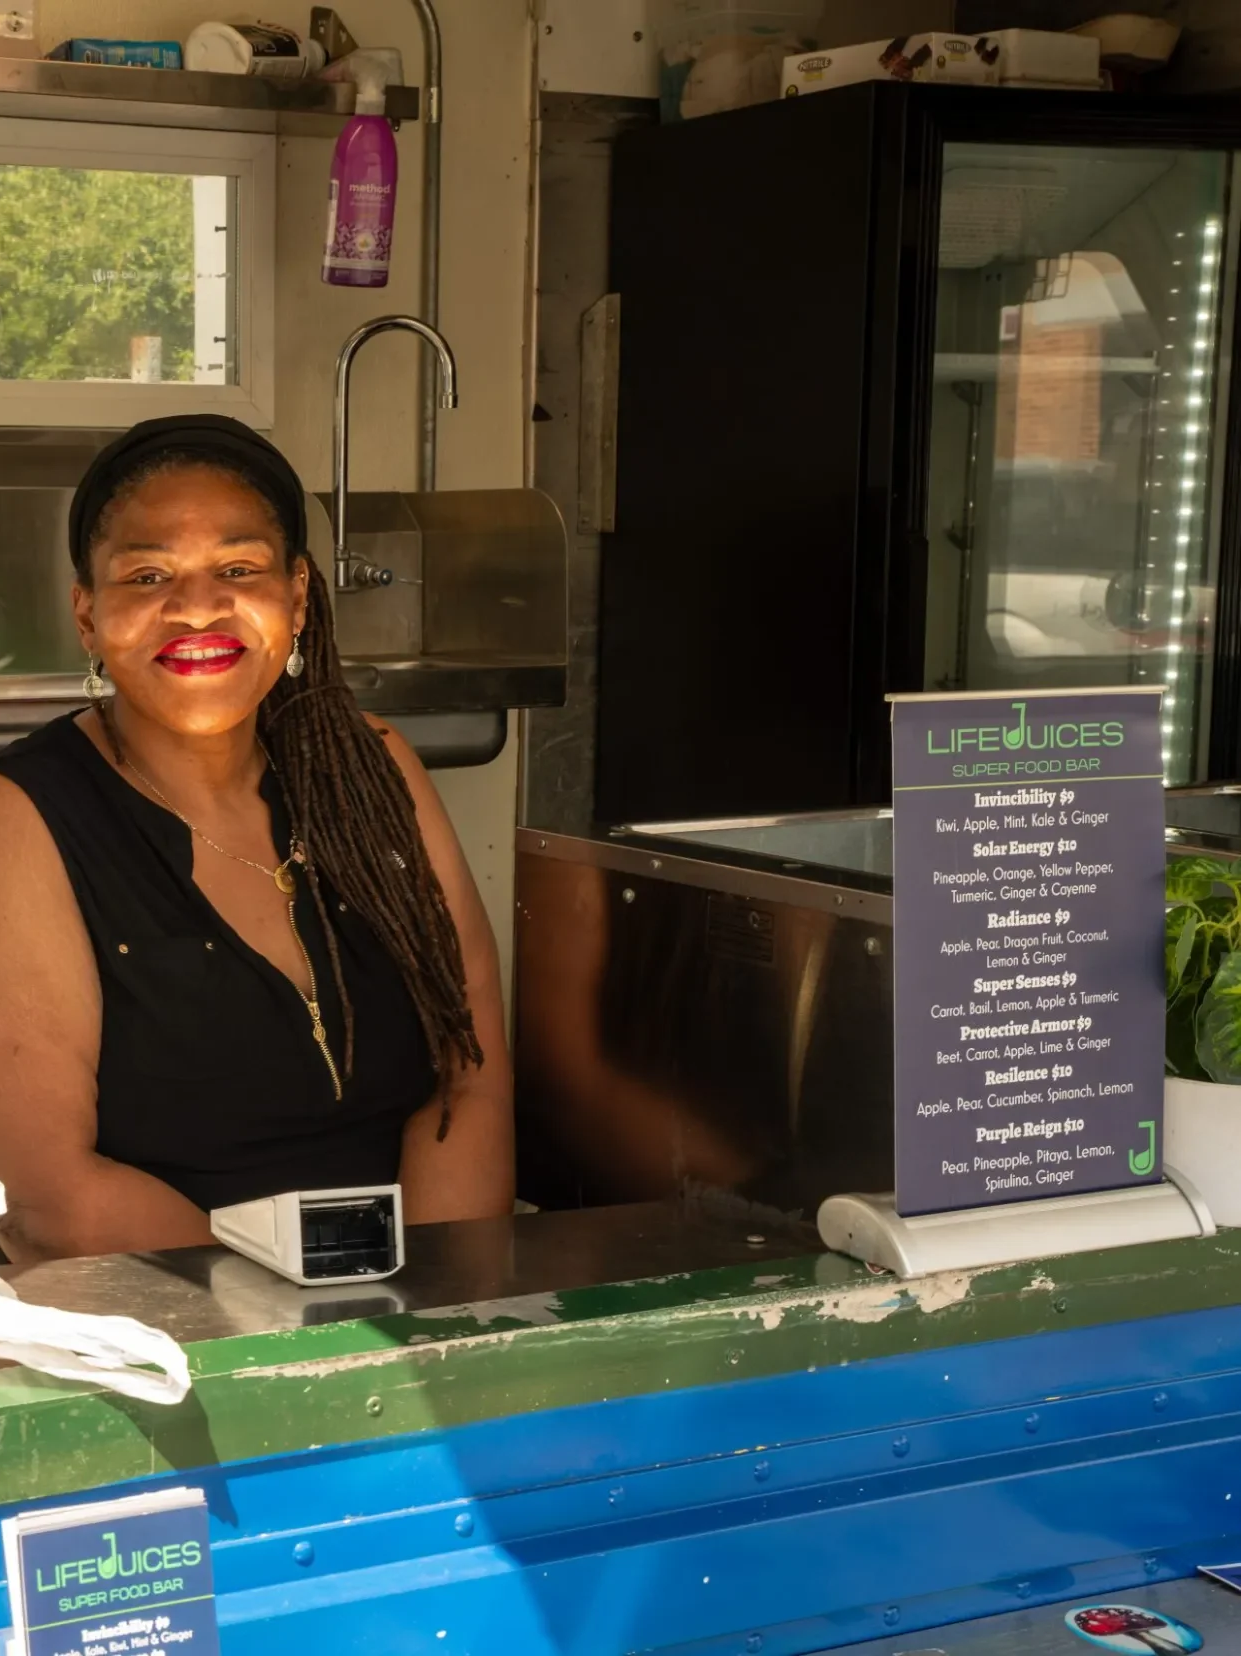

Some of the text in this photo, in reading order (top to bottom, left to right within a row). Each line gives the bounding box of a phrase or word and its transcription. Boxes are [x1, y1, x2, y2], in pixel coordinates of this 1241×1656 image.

[799, 57, 830, 70] NITRILE
[349, 184, 391, 193] method
[927, 702, 1124, 754] LIFEJUICES
[952, 757, 1100, 777] SUPER FOOD BAR
[975, 788, 1074, 808] Invincibility $9
[1032, 813, 1055, 826] Kale
[1059, 811, 1067, 825] &
[1071, 811, 1108, 826] Ginger
[973, 838, 1077, 857] Solar Energy $10
[1040, 864, 1072, 878] Yellow
[1000, 886, 1036, 901] Ginger
[1039, 883, 1048, 896] &
[1052, 882, 1096, 897] Cayenne
[988, 909, 1070, 928] Radiance $9
[1004, 936, 1039, 952] Dragon
[987, 951, 1066, 968] Lemon & Ginger
[974, 971, 1076, 996] Super Senses $9
[1036, 994, 1065, 1010] Apple
[1069, 993, 1077, 1005] &
[1080, 991, 1118, 1004] Turmeric
[960, 1016, 1091, 1041] Protective Armor $9
[1040, 1041, 1063, 1053] Lime
[1066, 1038, 1074, 1051] &
[1078, 1037, 1110, 1051] Ginger
[985, 1064, 1072, 1085] Resilence $10
[1099, 1083, 1133, 1095] Lemon
[976, 1118, 1084, 1144] Purple Reign $10
[1036, 1170, 1073, 1185] Ginger
[36, 1532, 202, 1592] LIFEJUICES
[59, 1578, 184, 1612] SUPER FOOD BAR
[160, 1630, 193, 1643] Ginger
